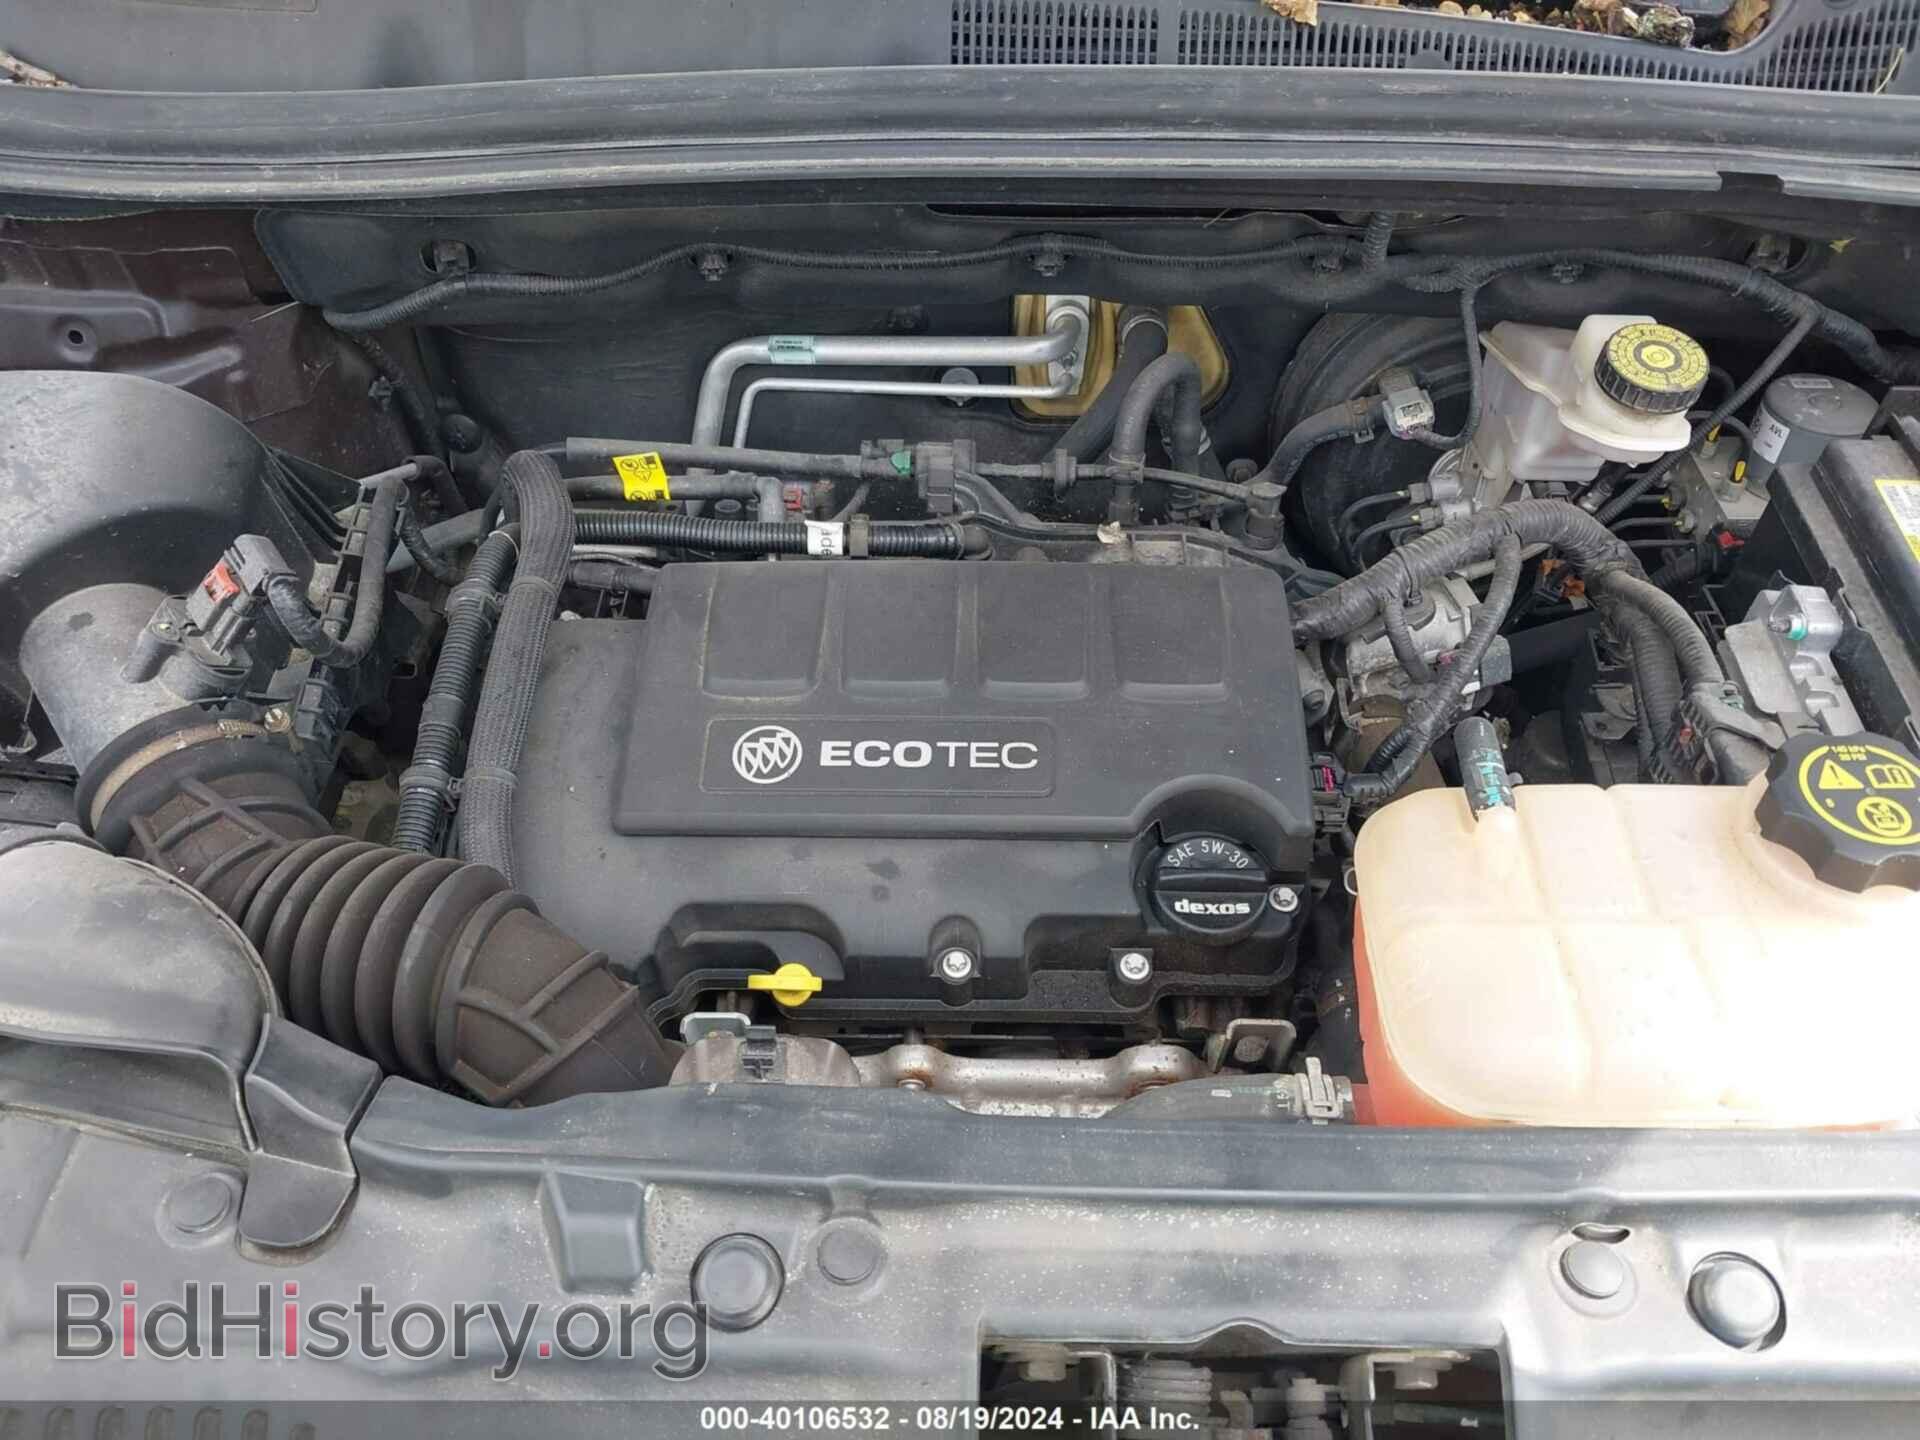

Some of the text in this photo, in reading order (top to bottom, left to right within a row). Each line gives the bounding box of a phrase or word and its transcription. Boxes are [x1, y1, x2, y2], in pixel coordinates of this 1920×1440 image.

[819, 740, 1039, 770] ECOTEC
[1167, 840, 1249, 869] SAE 5W-30
[1173, 898, 1251, 915] dexos
